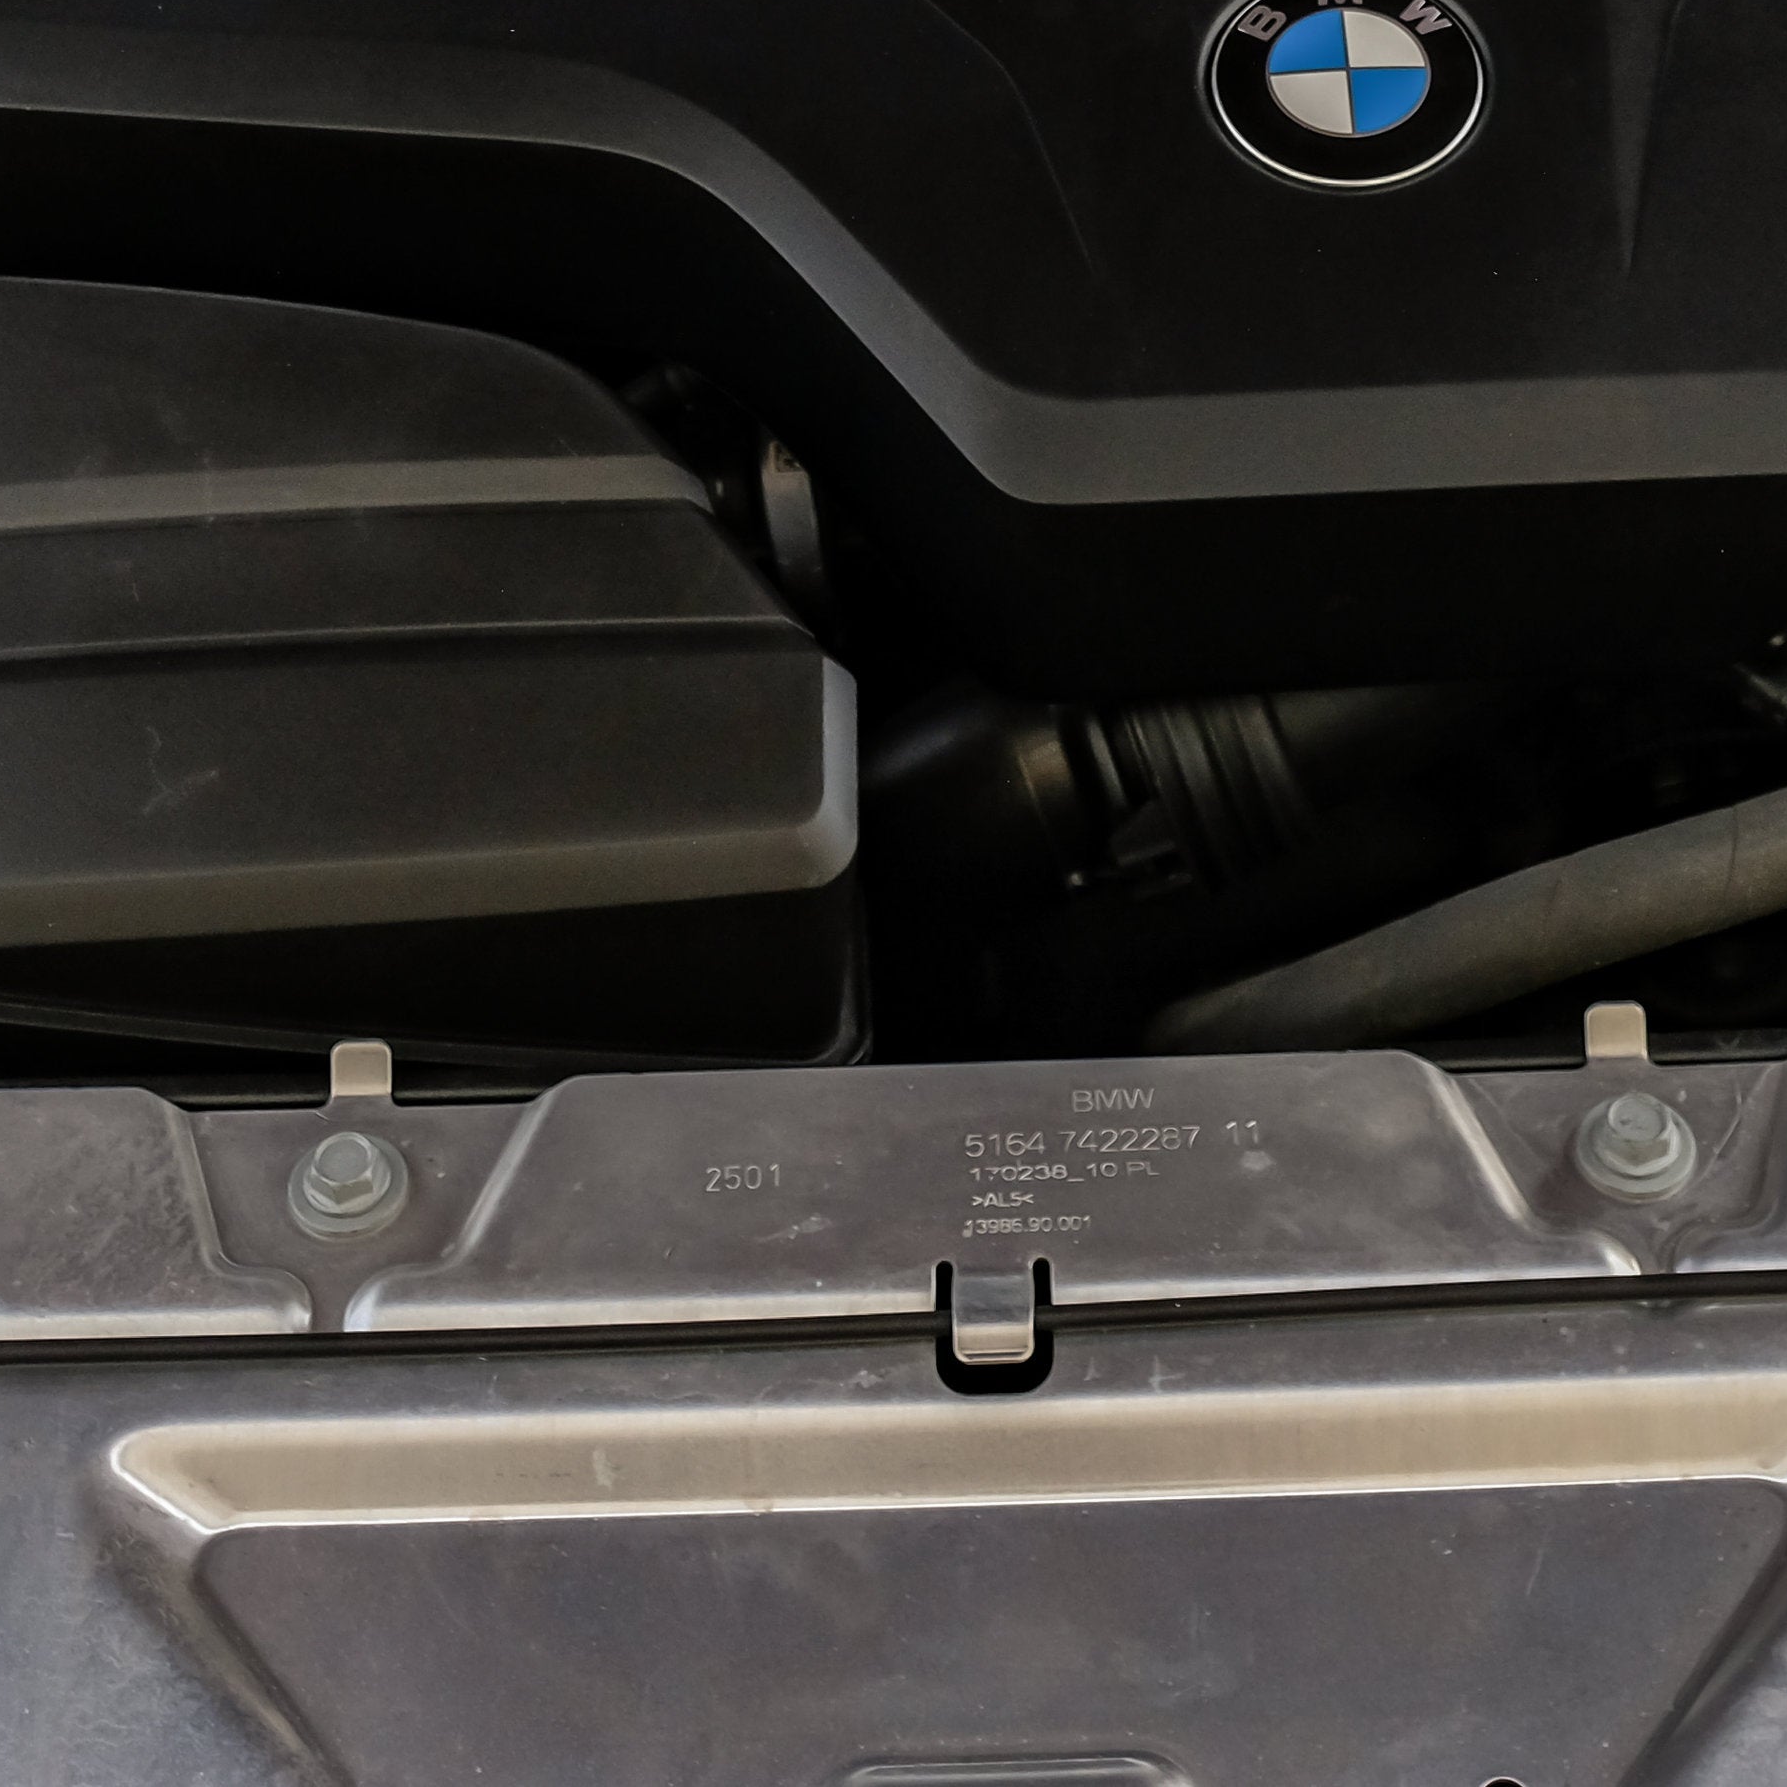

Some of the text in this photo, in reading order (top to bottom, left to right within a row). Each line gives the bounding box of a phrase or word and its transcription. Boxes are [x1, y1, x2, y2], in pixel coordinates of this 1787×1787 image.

[1071, 1088, 1155, 1112] BMW
[964, 1119, 1259, 1158] 5164 7422287 11
[705, 1163, 781, 1192] 2501
[1126, 1160, 1160, 1177] PL
